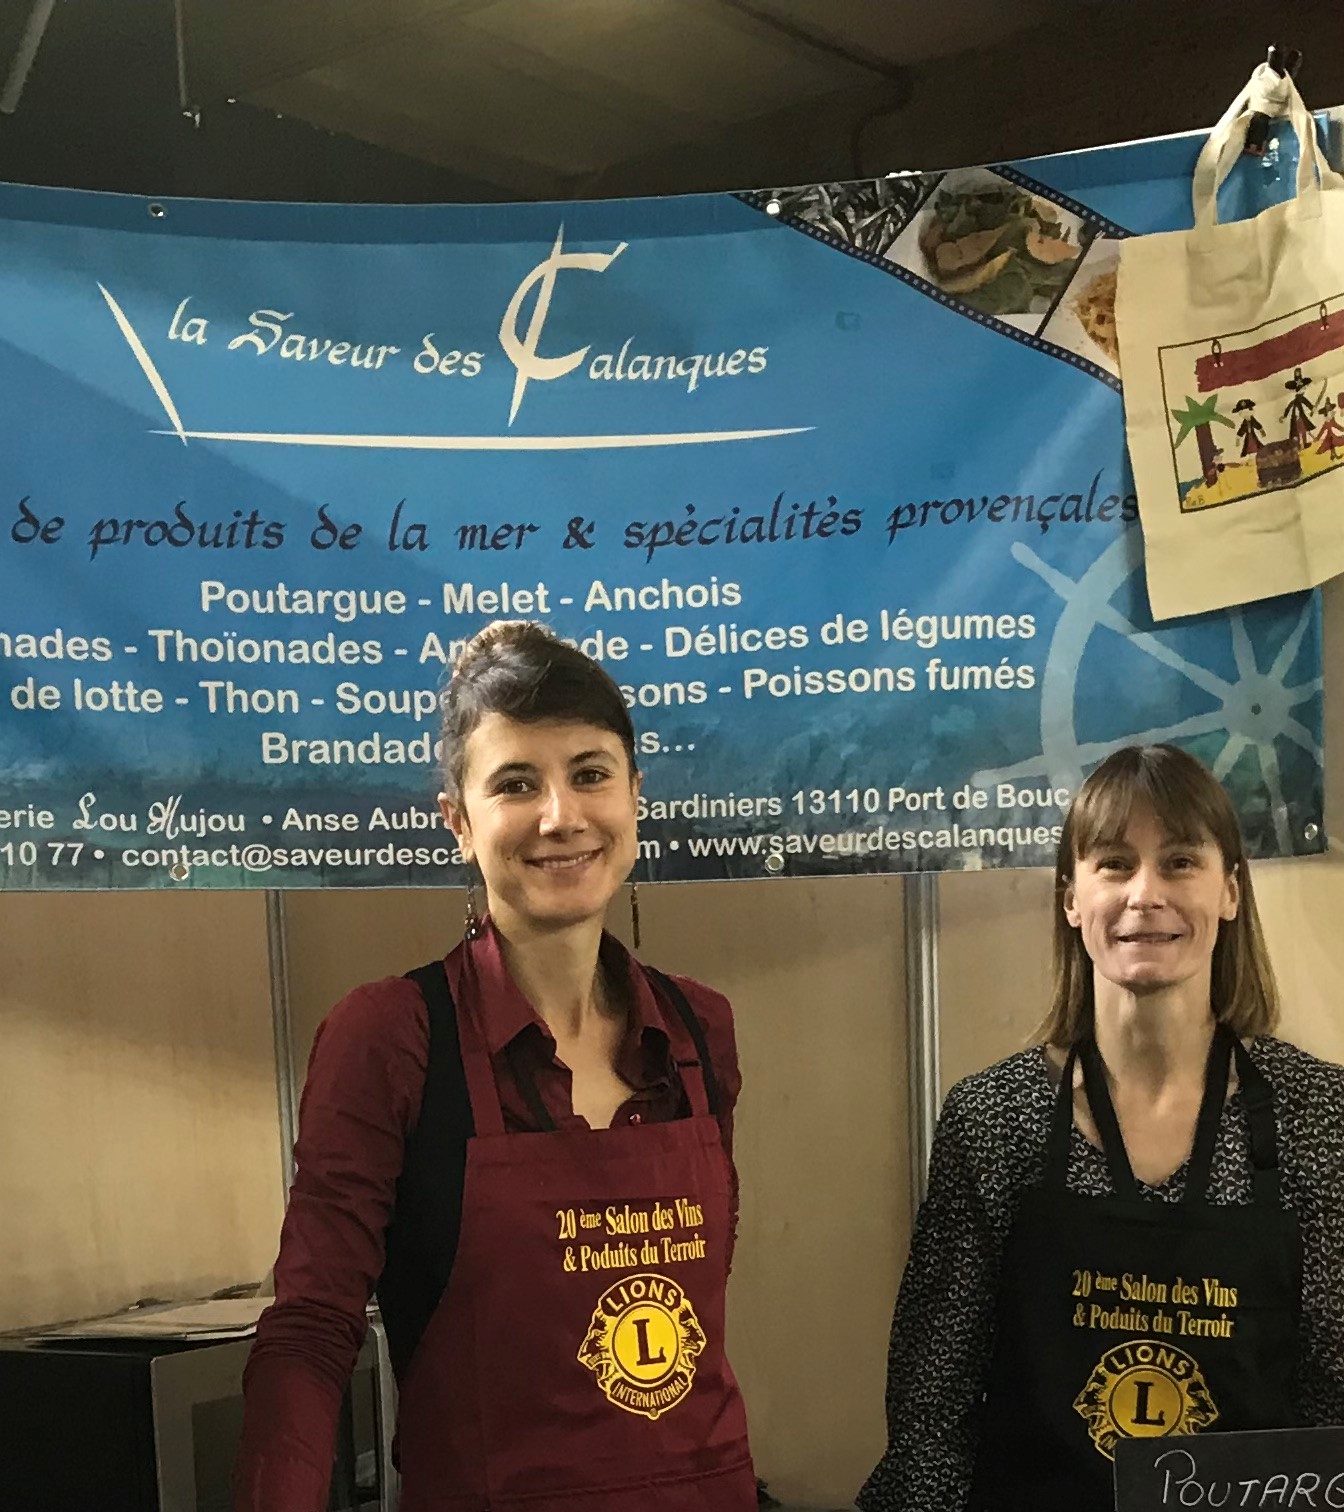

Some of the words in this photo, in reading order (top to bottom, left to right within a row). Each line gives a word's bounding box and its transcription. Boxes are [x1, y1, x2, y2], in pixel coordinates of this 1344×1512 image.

[168, 297, 208, 345] la
[227, 309, 402, 371] Saveur
[413, 333, 485, 378] des
[499, 227, 769, 427] Calanques
[10, 496, 67, 545] de
[89, 501, 286, 562] produits
[310, 503, 363, 551] de
[388, 498, 429, 552] la
[456, 520, 540, 552] mer
[562, 516, 596, 550] &
[885, 467, 1140, 547] provençales
[201, 581, 406, 623] Poutargue
[443, 581, 551, 615] Melet
[584, 576, 742, 612] Anchois
[148, 629, 383, 665] Thoïonades
[665, 622, 808, 659] Délices
[821, 614, 868, 645] de
[880, 608, 1035, 648] légumes
[11, 677, 61, 711] de
[74, 678, 163, 713] lotte
[198, 681, 299, 713] Thon
[744, 665, 916, 700] Poissons
[926, 657, 1035, 691] fumés
[72, 792, 137, 831] Lou
[282, 808, 359, 832] Anse
[636, 794, 782, 822] Sardiniers
[791, 788, 880, 815] 13110
[888, 785, 945, 813] Port
[953, 785, 987, 810] de
[997, 784, 1069, 808] Bouc
[0, 841, 37, 866] 10
[47, 841, 84, 866] 77
[556, 1208, 577, 1240] 20
[579, 1208, 602, 1228] ème
[605, 1204, 649, 1236] Salon
[651, 1201, 675, 1231] des
[674, 1197, 704, 1229] Vins
[563, 1246, 577, 1272] &
[579, 1241, 638, 1272] Poduits
[640, 1239, 659, 1266] du
[660, 1233, 707, 1264] Terroir
[606, 1279, 679, 1313] LIONS
[1072, 1270, 1091, 1297] 20
[1095, 1270, 1118, 1291] ème
[1119, 1272, 1167, 1304] Salon
[1171, 1276, 1199, 1306] des
[1202, 1278, 1238, 1308] Vins
[632, 1318, 667, 1366] L
[1073, 1303, 1086, 1327] &
[1090, 1303, 1149, 1332] Poduits
[1152, 1309, 1173, 1334] du
[1177, 1310, 1235, 1338] Terroir
[1109, 1345, 1190, 1376] LIONS
[613, 1376, 689, 1409] INTERNATIONAL
[1131, 1381, 1166, 1426] L
